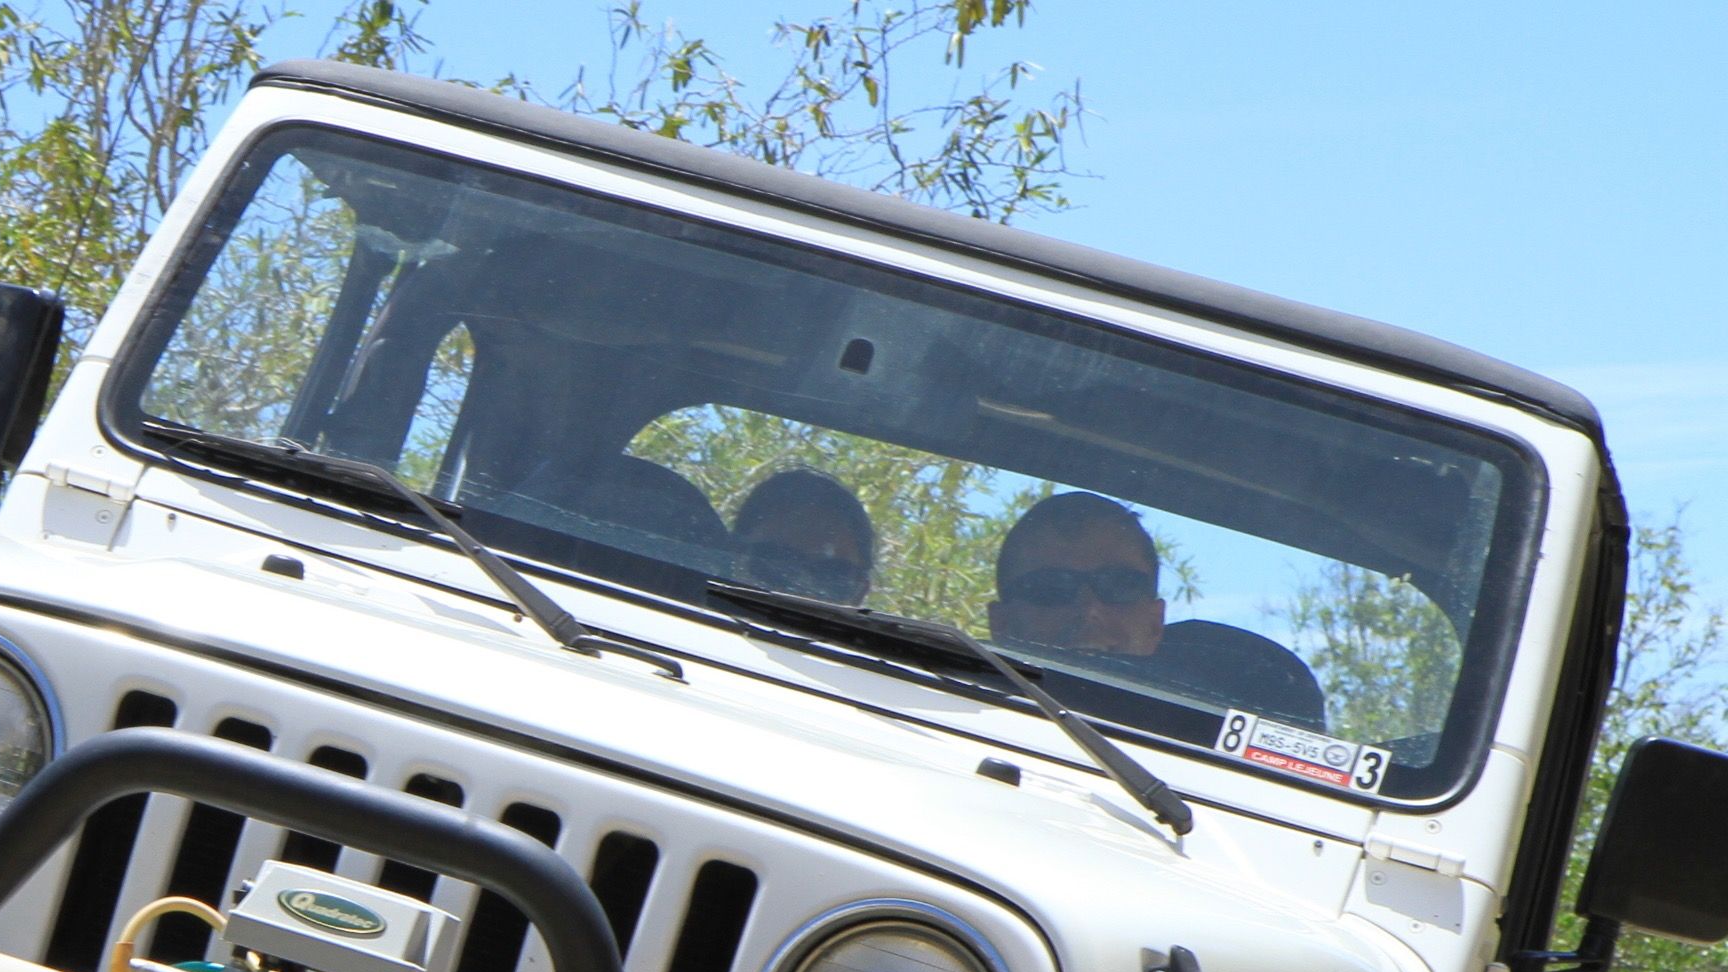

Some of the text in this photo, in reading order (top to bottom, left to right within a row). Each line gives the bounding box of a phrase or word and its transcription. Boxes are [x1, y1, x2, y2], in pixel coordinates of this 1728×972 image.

[1223, 714, 1246, 752] 8
[1251, 751, 1344, 783] CAMP LEJEUNE
[1356, 752, 1382, 790] 3
[290, 893, 378, 929] Quadratec
